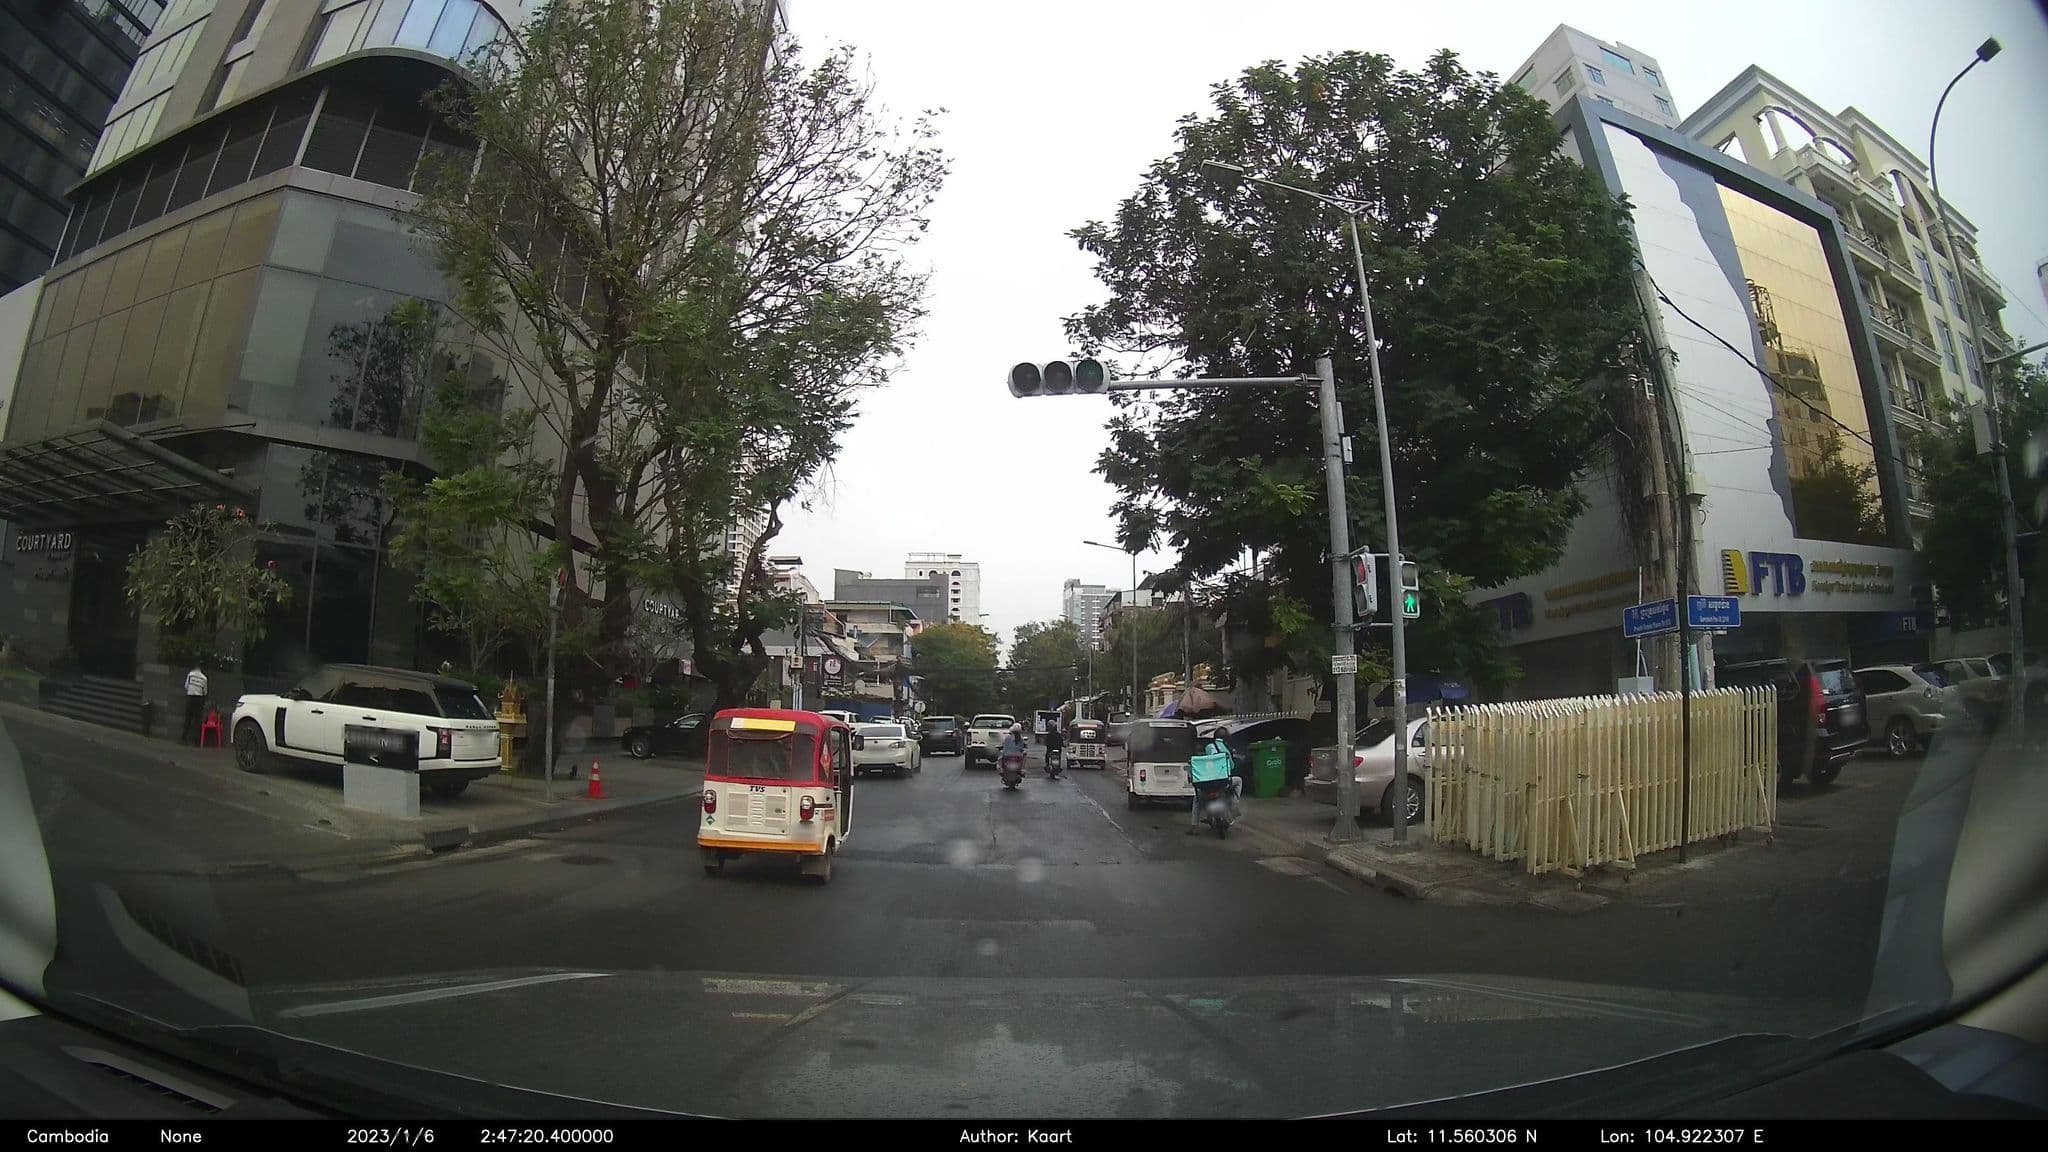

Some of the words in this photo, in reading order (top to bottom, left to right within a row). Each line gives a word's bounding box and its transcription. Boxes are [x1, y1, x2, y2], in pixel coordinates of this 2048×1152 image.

[16, 533, 72, 551] COURTYARD
[1748, 551, 1806, 596] FTB
[644, 599, 681, 619] COURTYAR
[749, 785, 766, 793] TVS
